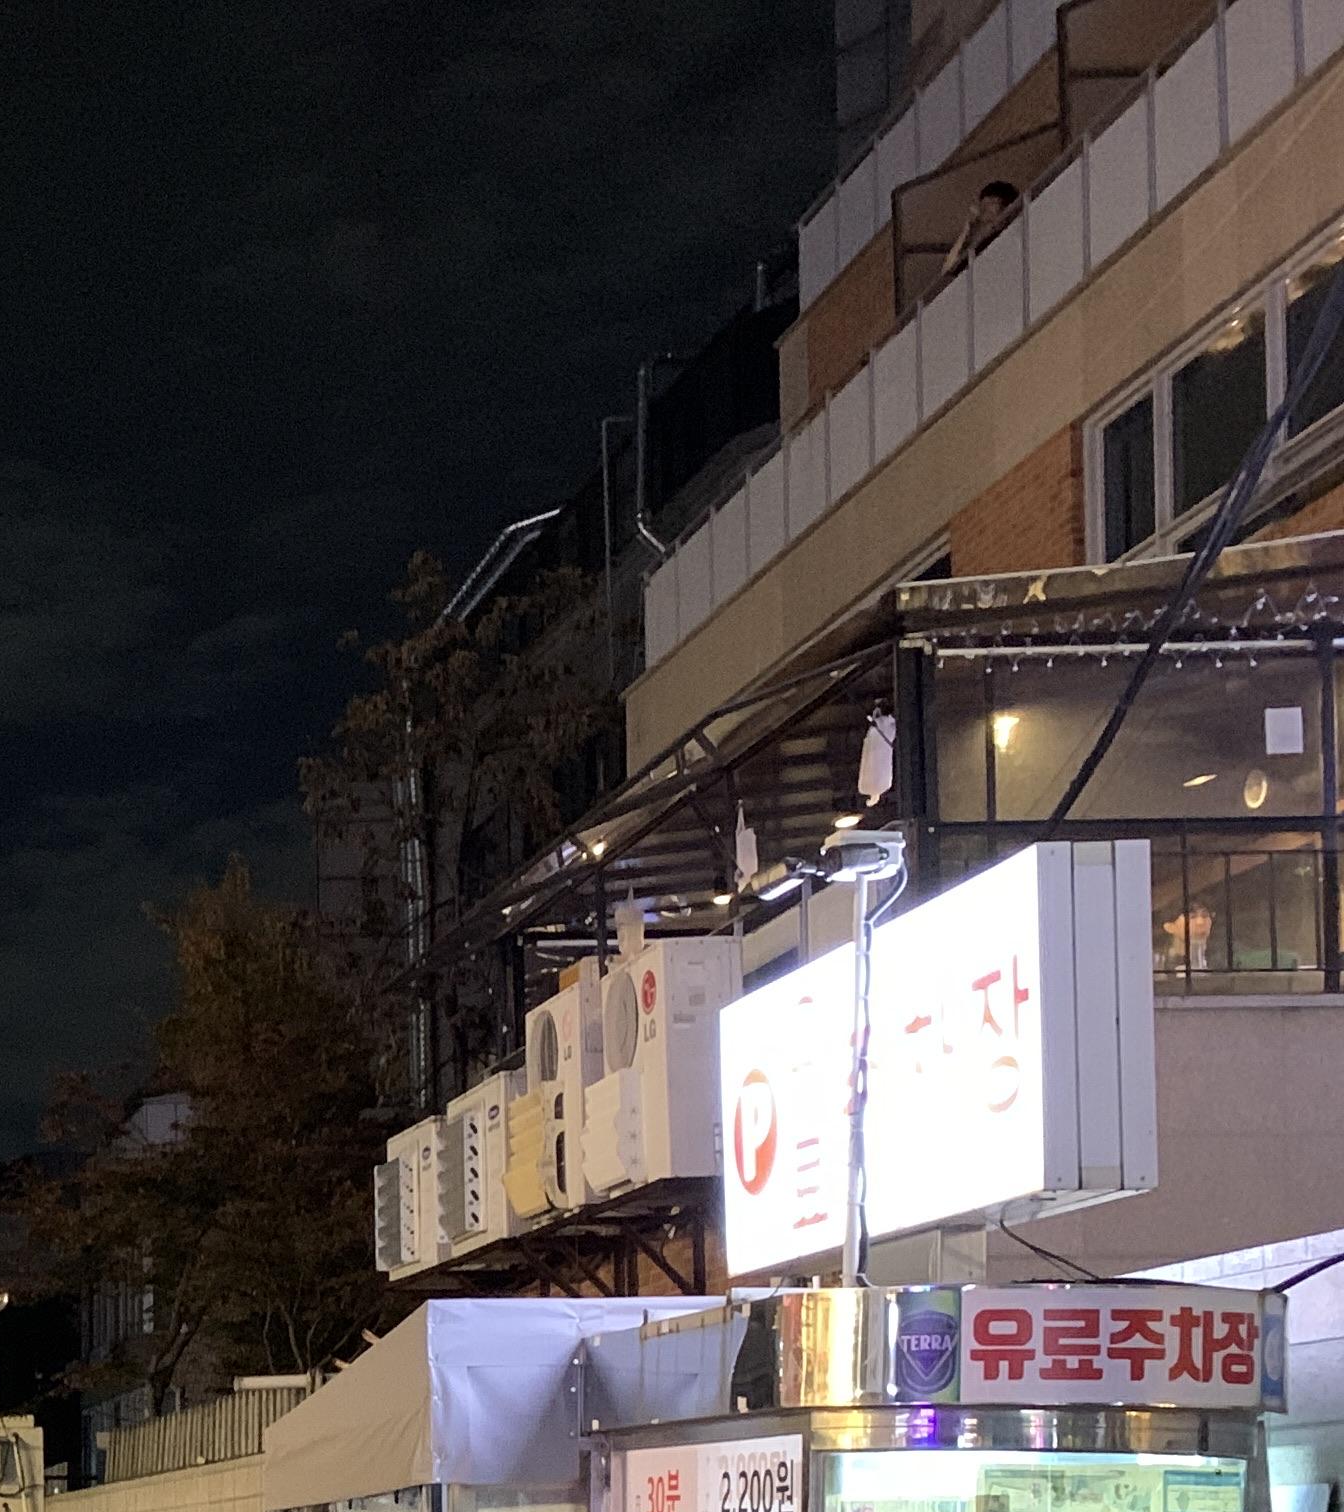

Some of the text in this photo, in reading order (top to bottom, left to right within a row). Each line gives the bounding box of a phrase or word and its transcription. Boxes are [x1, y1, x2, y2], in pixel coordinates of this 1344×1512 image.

[643, 1018, 657, 1043] LG
[900, 1334, 953, 1353] TERRA
[970, 1306, 1260, 1385] 유료주차장
